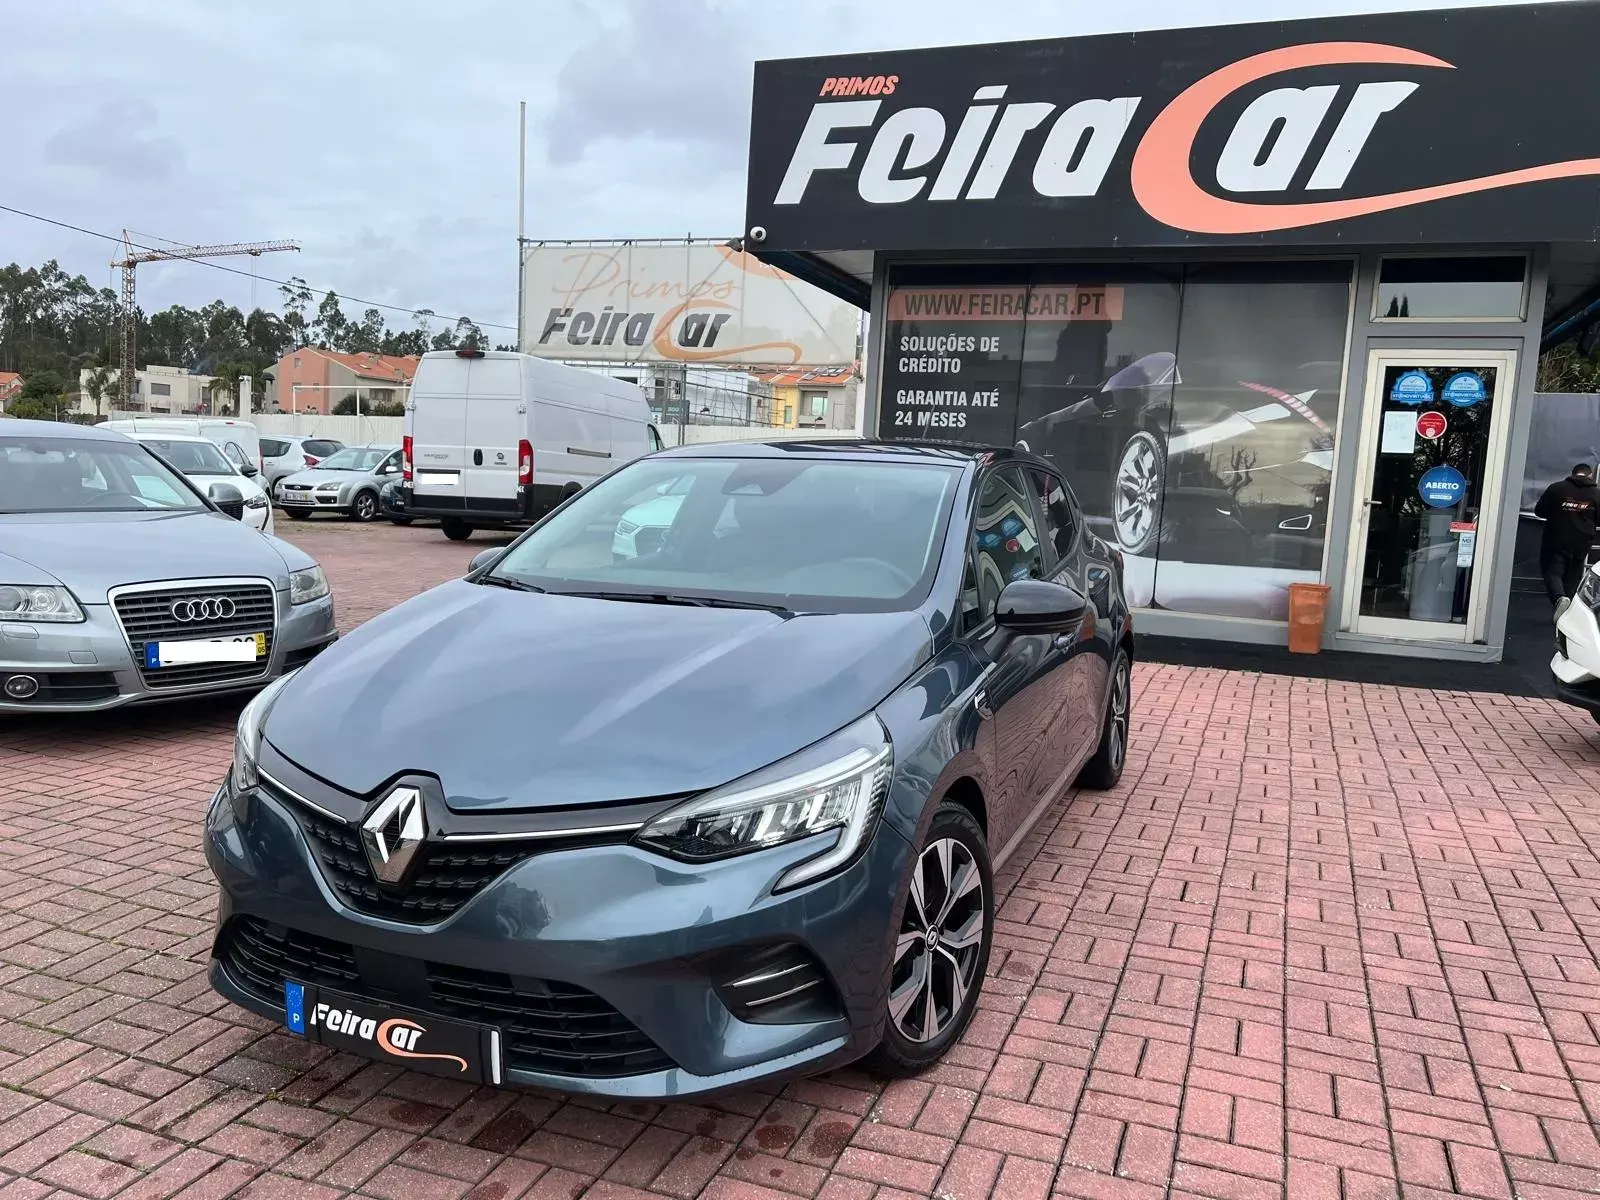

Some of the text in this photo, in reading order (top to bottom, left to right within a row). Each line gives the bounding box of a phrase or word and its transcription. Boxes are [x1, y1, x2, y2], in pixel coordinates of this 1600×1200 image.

[819, 75, 899, 97] PRIMOS
[551, 251, 741, 316] Primos
[904, 293, 1105, 316] WWW.FEIRACAR.PT
[900, 333, 1000, 356] SOLUÇÕES DE
[898, 354, 961, 374] CRÉDITO
[896, 388, 999, 408] GARANTIA ATÉ
[894, 411, 967, 428] 24 MESES
[1425, 481, 1460, 490] ABERTO
[293, 1013, 300, 1024] P
